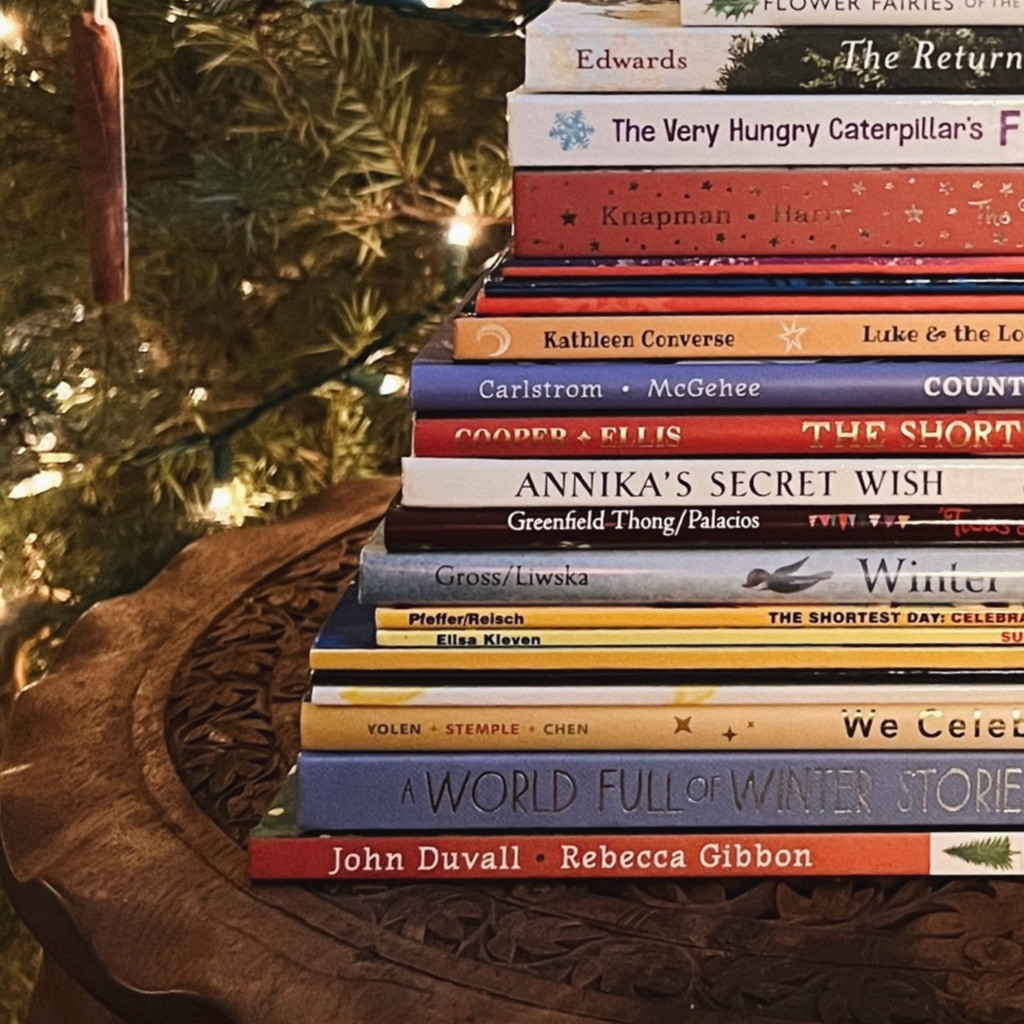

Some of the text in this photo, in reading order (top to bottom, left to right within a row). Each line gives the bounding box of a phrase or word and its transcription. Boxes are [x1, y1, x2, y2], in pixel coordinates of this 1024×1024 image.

[576, 49, 688, 69] Edwards
[842, 40, 899, 70] The
[913, 40, 1023, 69] Return
[612, 118, 655, 143] The
[664, 118, 719, 147] Very
[730, 117, 819, 147] Hungry
[829, 116, 983, 146] Caterpillar's
[602, 207, 731, 230] Knapman
[543, 330, 735, 349] Kathleen Converse
[863, 325, 918, 342] Luke
[926, 325, 946, 342] &
[954, 324, 990, 342] the
[479, 379, 760, 399] Carlstrom McGehee
[455, 427, 681, 448] COOPER ELLIS
[802, 421, 885, 448] THE
[516, 470, 943, 498] ANNIKA'S SECRET WISH
[508, 510, 759, 536] Greenfield Thong/Palacios
[435, 566, 589, 587] Gross/Liwska
[409, 612, 524, 626] Pfeffer/Reisch
[769, 612, 803, 623] THE
[809, 612, 900, 623] SHORTEST
[908, 612, 946, 623] DAY:
[436, 634, 541, 646] Elisa Kleven
[367, 724, 588, 735] YOLEN STEMPLE CHEN
[841, 710, 898, 738] We
[402, 778, 415, 805] A
[424, 770, 577, 815] WORLD
[599, 769, 684, 814] FULL
[686, 776, 721, 802] OF
[731, 768, 872, 813] WINTER
[329, 843, 813, 874] John Duvall Rebecca Gibbon
